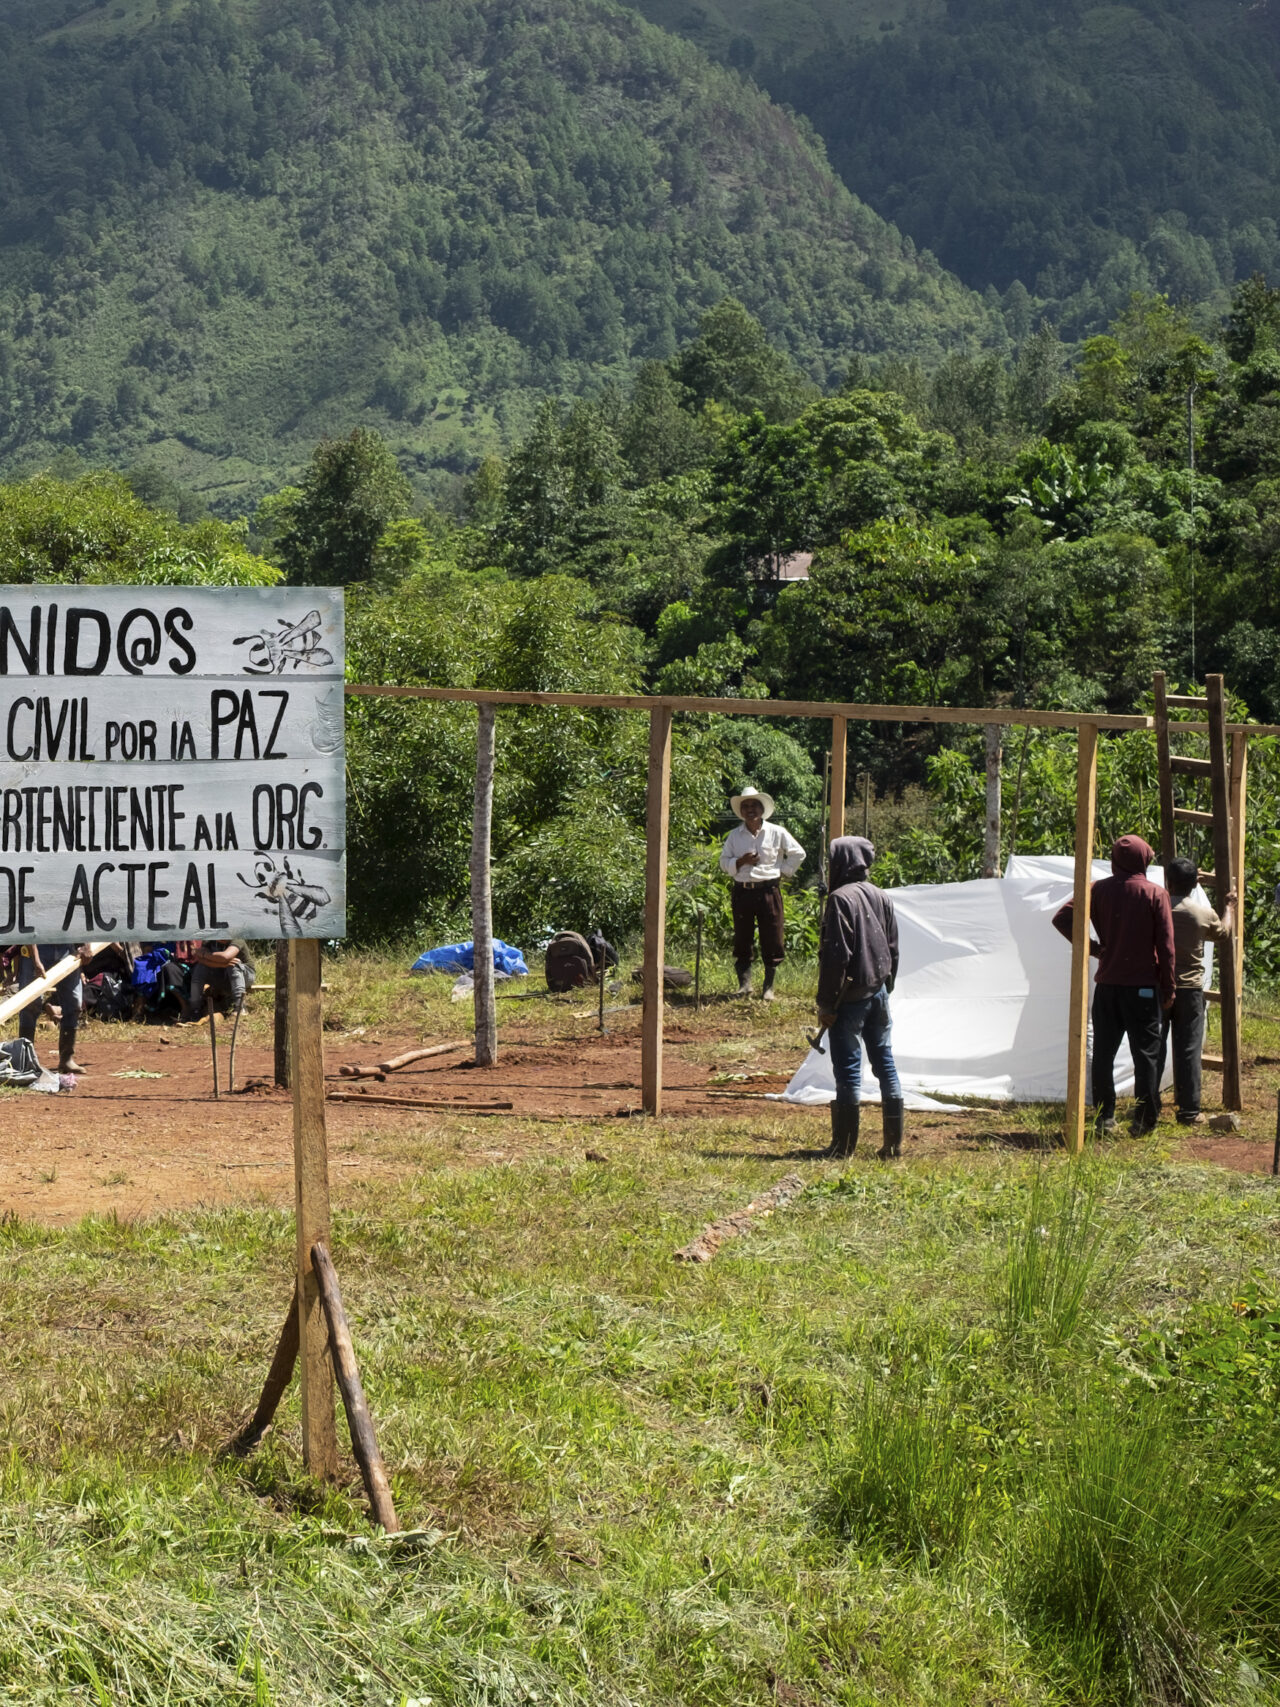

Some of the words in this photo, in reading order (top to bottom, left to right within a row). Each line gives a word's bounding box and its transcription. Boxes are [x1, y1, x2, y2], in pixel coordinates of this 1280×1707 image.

[7, 696, 95, 761] CIVIL
[105, 720, 157, 761] POR
[211, 689, 289, 760] PAZ
[252, 781, 328, 850] ORG.
[61, 861, 229, 932] ACTEAL
